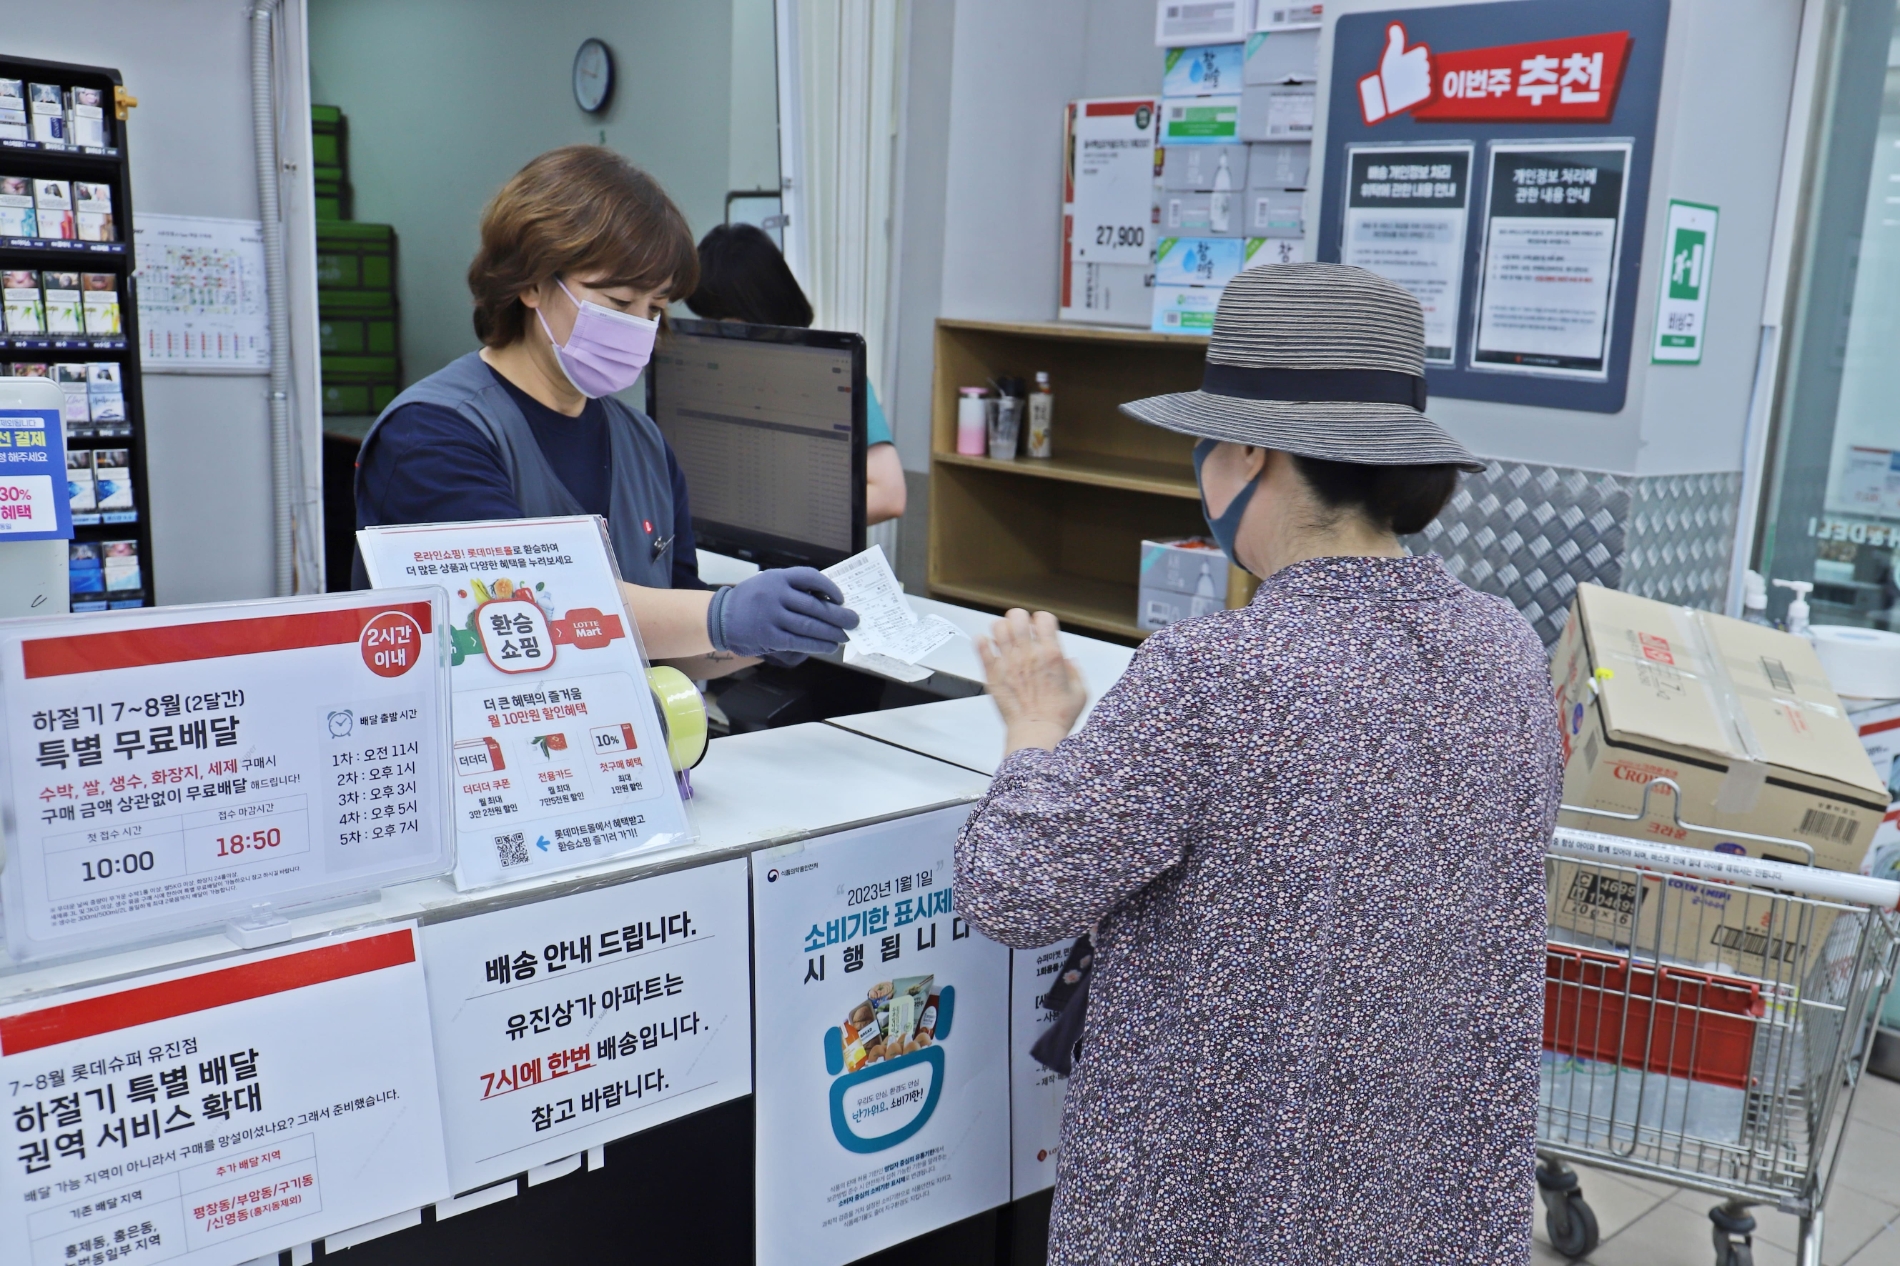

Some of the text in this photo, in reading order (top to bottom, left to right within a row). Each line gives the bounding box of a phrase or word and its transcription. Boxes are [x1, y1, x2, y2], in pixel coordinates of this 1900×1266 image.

[1442, 52, 1604, 106] 이번주 추천
[1096, 225, 1144, 249] 27,900
[14, 431, 47, 447] 결제
[8, 451, 48, 463] 해주세요
[0, 504, 32, 520] 혜택
[406, 555, 573, 576] 더 많은 상품과 다양한 혜택을 누려보세요
[413, 549, 466, 562] 온라인쇼핑!
[523, 543, 559, 555] 환승하여
[367, 625, 412, 648] 2시간
[490, 612, 533, 636] 환승
[573, 620, 600, 629] LOTTE
[575, 628, 602, 638] Mart
[374, 648, 407, 669] 이내
[501, 636, 541, 659] 쇼핑
[32, 689, 245, 732] 하절기 7~8월 (2달간)
[484, 687, 582, 711] 더 큰 혜택의 즐거움
[360, 709, 417, 726] 배달 출발 시간
[488, 702, 588, 728] 월 10만원 할인혜택
[36, 715, 240, 770] 특별 무료배달
[596, 734, 620, 747] 10%
[332, 741, 418, 767] 1차 오전 11시
[459, 753, 488, 767] 더더더
[599, 757, 643, 773] 첫구매 혜택
[38, 754, 277, 803] 수박, 쌀, 생수, 화장지, 세제 구매시
[337, 761, 416, 786] 2차 오후 1시
[463, 778, 511, 795] 더더더 쿠폰
[538, 768, 574, 783] 전용카드
[41, 774, 302, 825] 구매 금액 상관없이 무료배달 해드립니다!
[338, 781, 416, 806] 3차 오후 3시
[611, 784, 629, 795] 1만원
[218, 803, 275, 821] 접수 마감시간
[339, 800, 417, 826] 4차 오후 5시
[87, 825, 143, 843] 첫 접수 시간
[340, 819, 418, 846] 5차 오후 7시
[555, 814, 646, 840] 롯데마트몰에서 혜택받고
[557, 828, 639, 852] 환승쇼핑 즐기러 가기!
[216, 827, 281, 857] 18:50
[82, 851, 155, 882] 10:00
[847, 869, 933, 907] 2023년 1월 1일
[803, 887, 954, 953] 소비기한 표시제
[485, 911, 697, 985] 배송 안내 드립니다.
[505, 973, 684, 1041] 유진상가 아파트는
[8, 1036, 199, 1097] 7~8월 롯데슈퍼 유진점
[480, 1011, 710, 1100] 7시에 한번 배송입니다.
[13, 1048, 260, 1133] 하절기 특별 배달
[531, 1068, 669, 1132] 참고 바랍니다.
[18, 1082, 263, 1175] 권역 서비스 확대
[24, 1088, 400, 1203] 배달 가능 지역이 아니라서 구매를 망설이셨나요? 그래서 준비했습니다.
[216, 1150, 281, 1177] 추가 배달 지역
[69, 1190, 143, 1219] 기존 배달 지역
[193, 1173, 314, 1221] 평창동/부암동/구기동
[65, 1221, 158, 1259] 홍제동, 홍은동,
